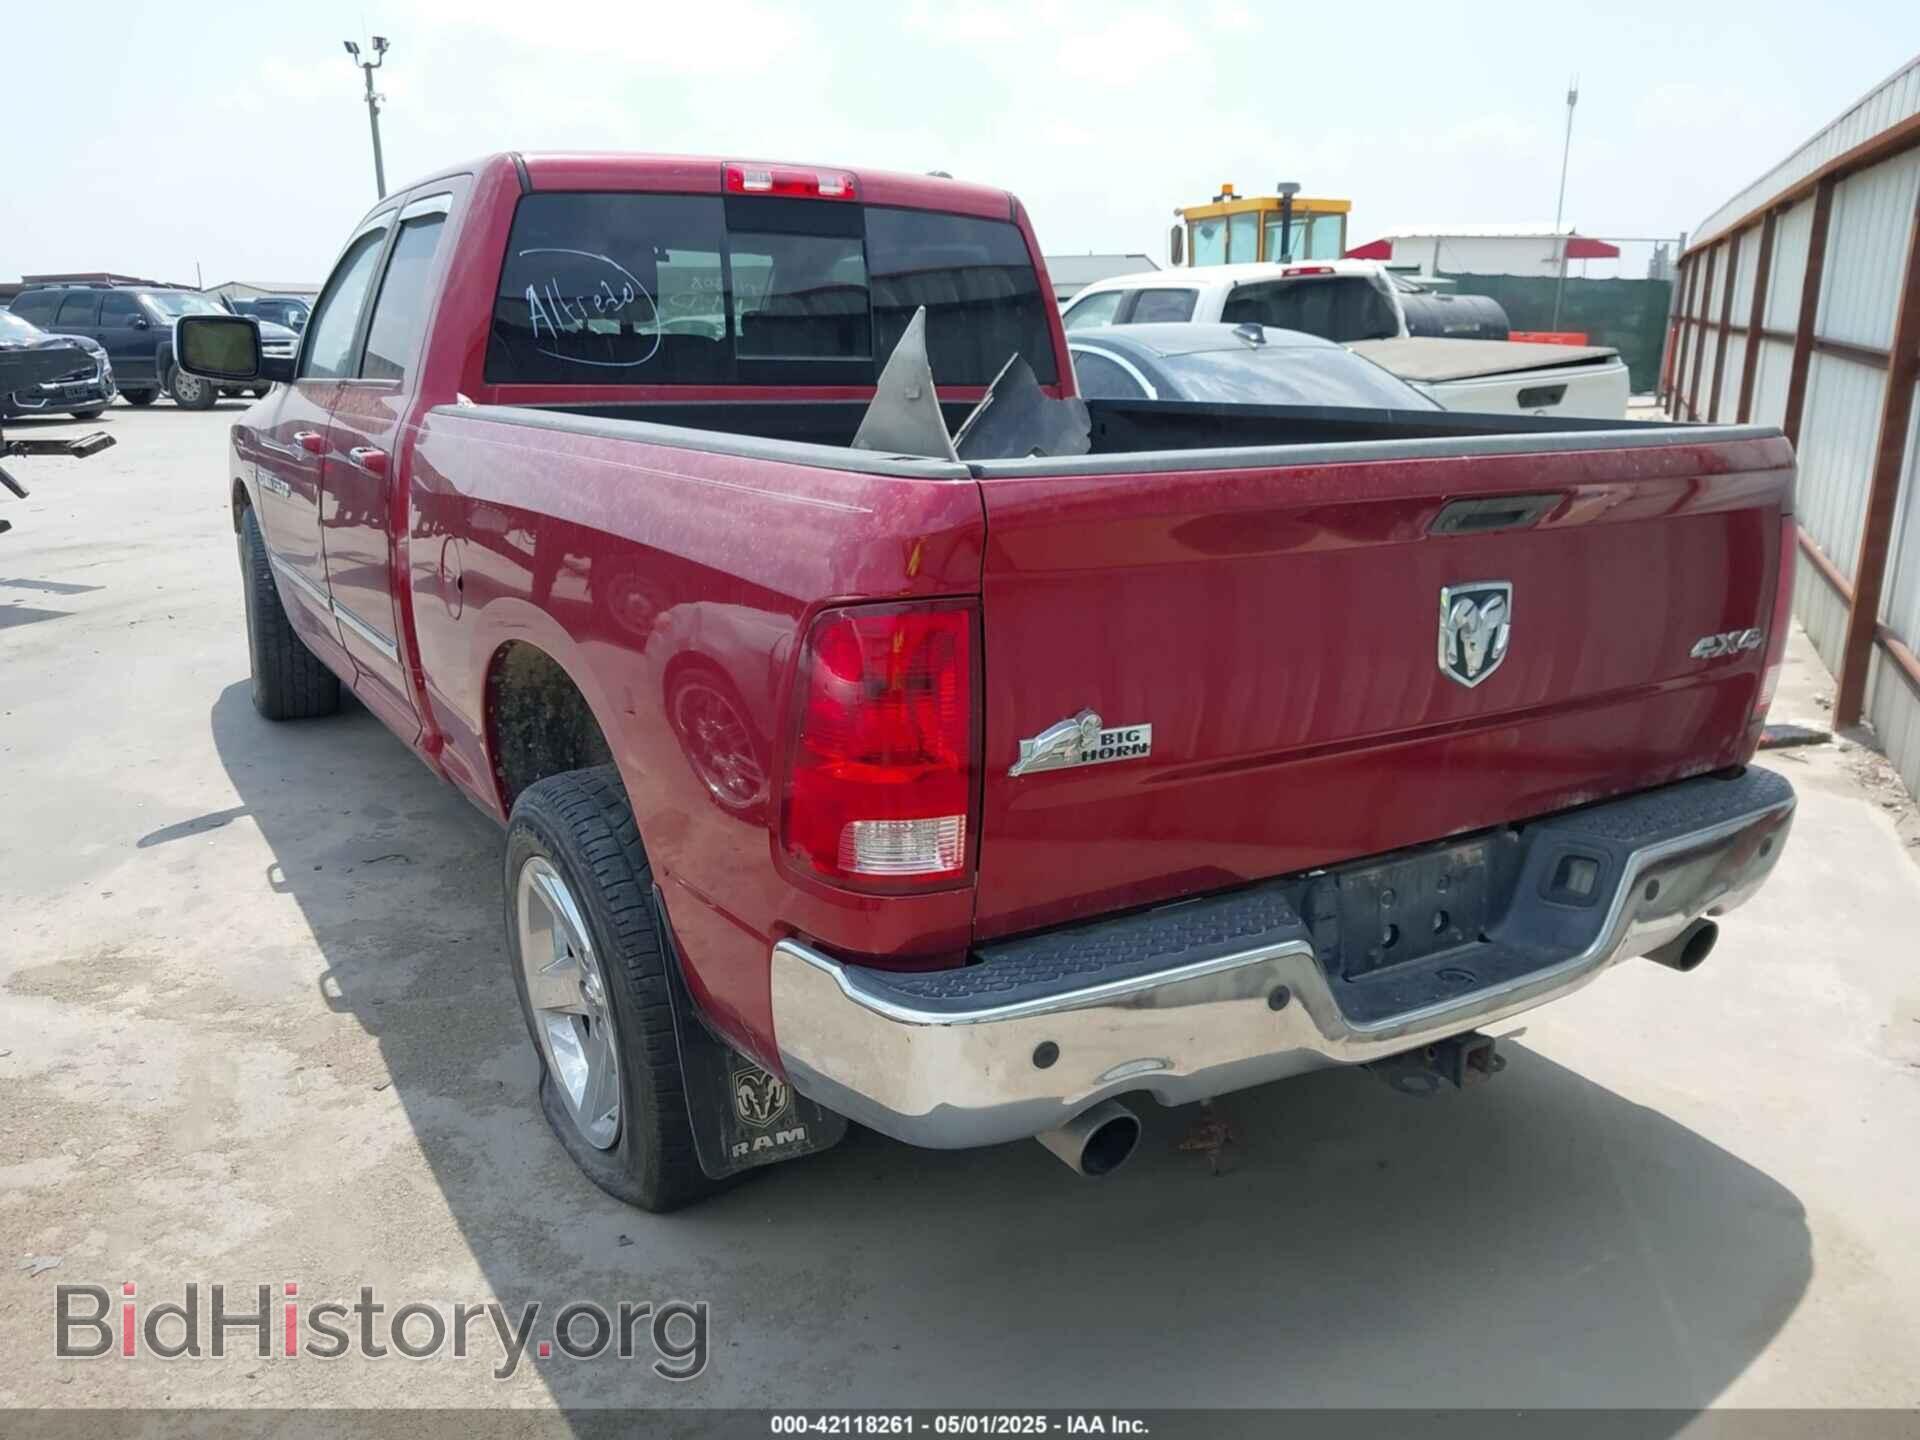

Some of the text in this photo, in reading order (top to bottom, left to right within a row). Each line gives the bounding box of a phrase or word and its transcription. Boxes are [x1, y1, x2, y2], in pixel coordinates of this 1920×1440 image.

[1100, 730, 1140, 746] BIG
[1081, 743, 1147, 762] HORN
[732, 1127, 806, 1158] RAM
